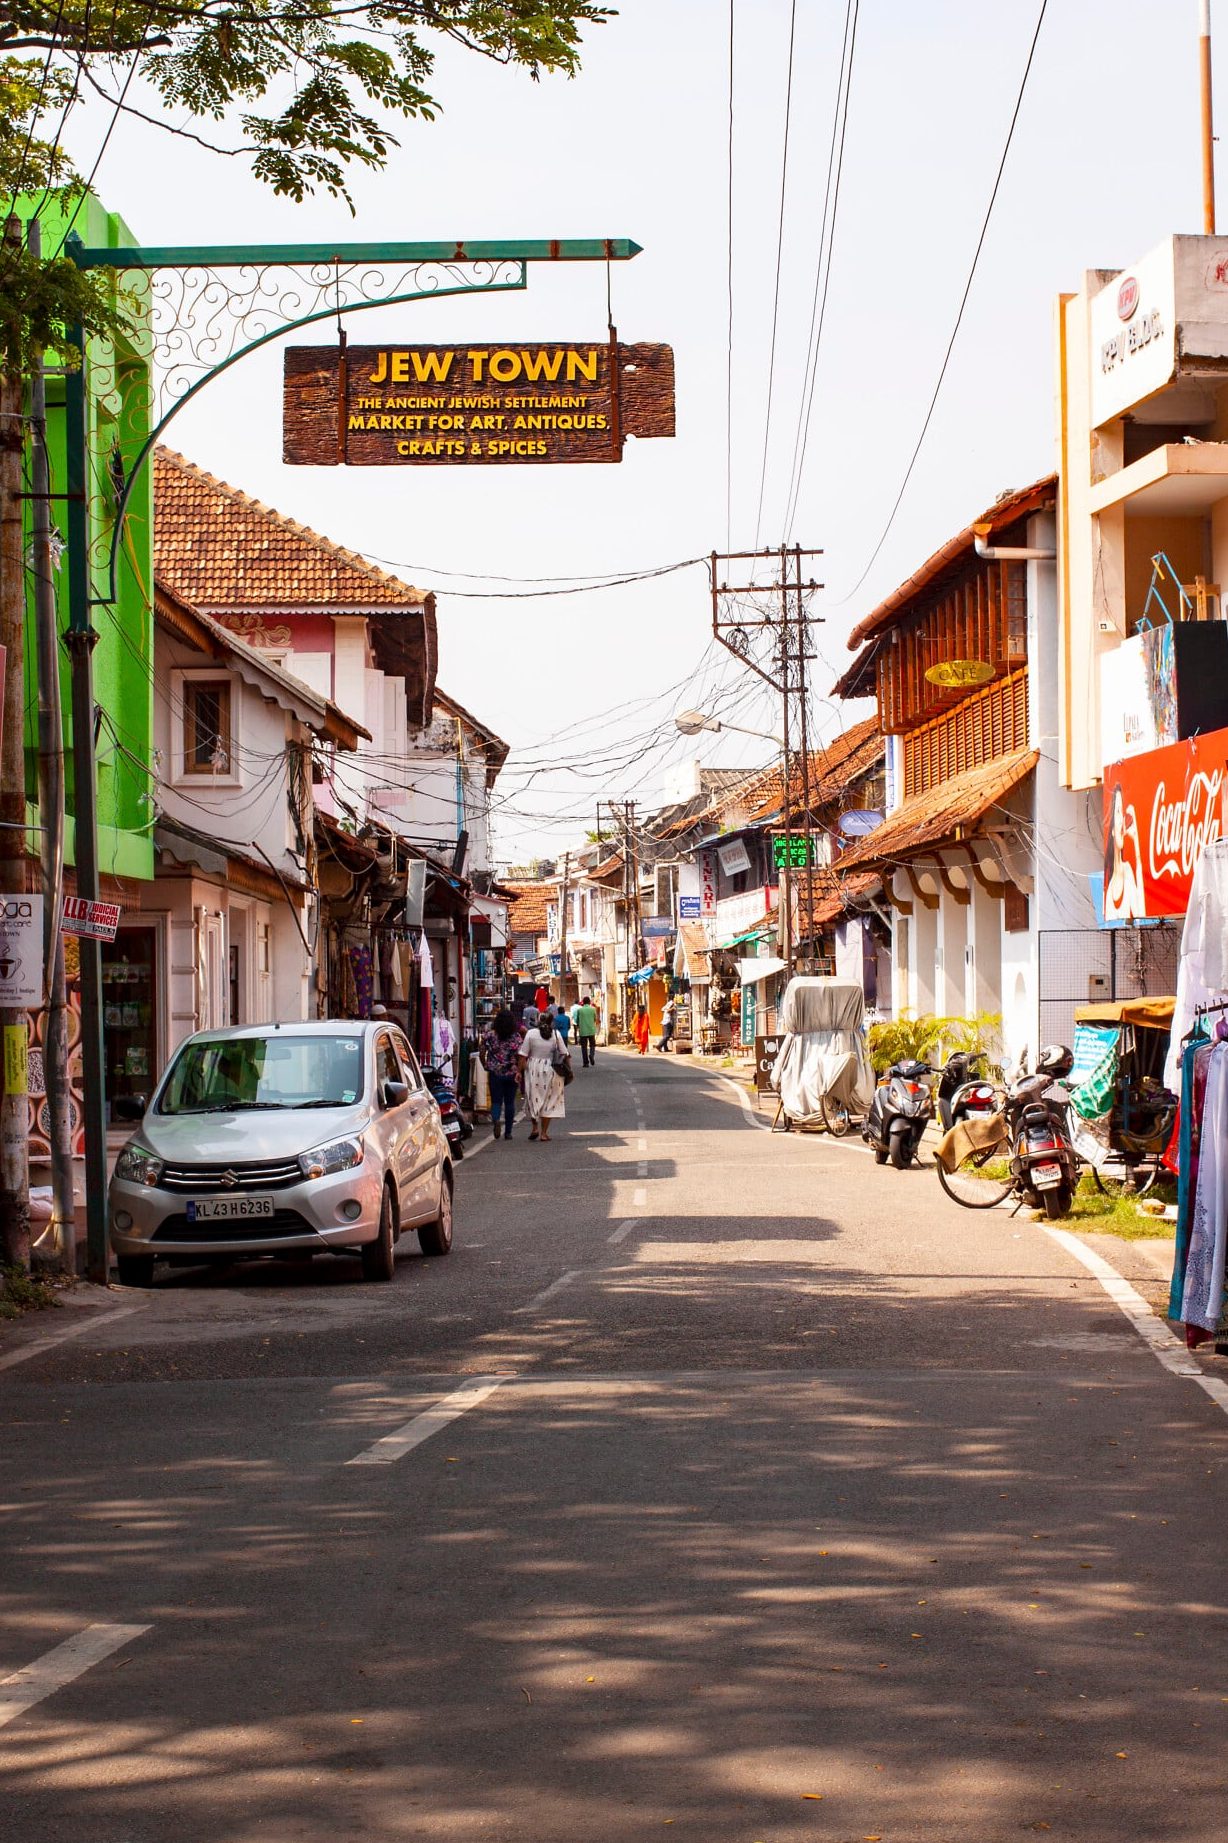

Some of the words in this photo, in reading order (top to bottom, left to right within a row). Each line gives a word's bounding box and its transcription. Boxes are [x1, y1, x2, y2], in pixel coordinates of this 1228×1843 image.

[369, 351, 454, 383] JEW
[467, 350, 598, 382] TOWN
[357, 397, 382, 409] THE
[384, 397, 446, 409] ANCIENT
[447, 396, 501, 409] JEWISH
[504, 396, 588, 409] SETTLEMENT
[348, 415, 424, 430] MARKET
[428, 415, 464, 430] FOR
[470, 415, 508, 432] ART,
[513, 414, 611, 431] ANTIQUES,
[397, 440, 465, 456] CRAFTS
[471, 440, 482, 455] &
[487, 440, 547, 455] SPICES
[781, 848, 807, 856] SICES
[702, 853, 713, 882] FINE
[703, 884, 715, 909] ART
[63, 897, 88, 920] LLB
[91, 902, 119, 917] JUDICIAL
[88, 912, 118, 927] SERVICES
[759, 1058, 774, 1072] Ca
